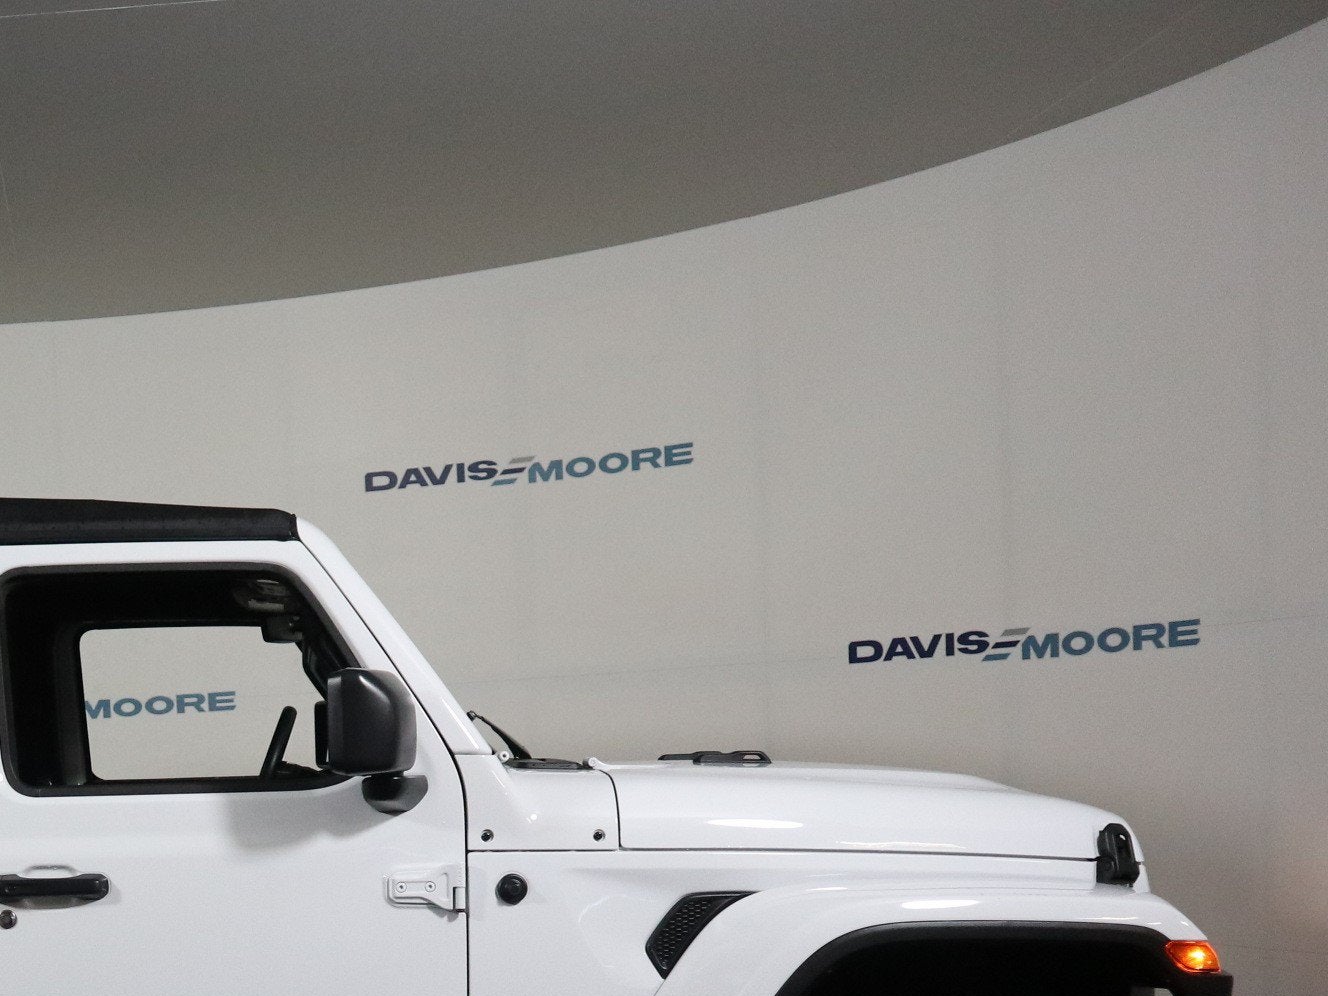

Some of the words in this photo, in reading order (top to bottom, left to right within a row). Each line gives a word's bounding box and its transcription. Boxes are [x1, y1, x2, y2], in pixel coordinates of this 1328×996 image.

[365, 460, 500, 492] DAVIS
[528, 442, 694, 484] MOORE
[848, 630, 990, 664] DAVIS
[1021, 619, 1201, 660] MOORE
[85, 691, 237, 719] MOORE
